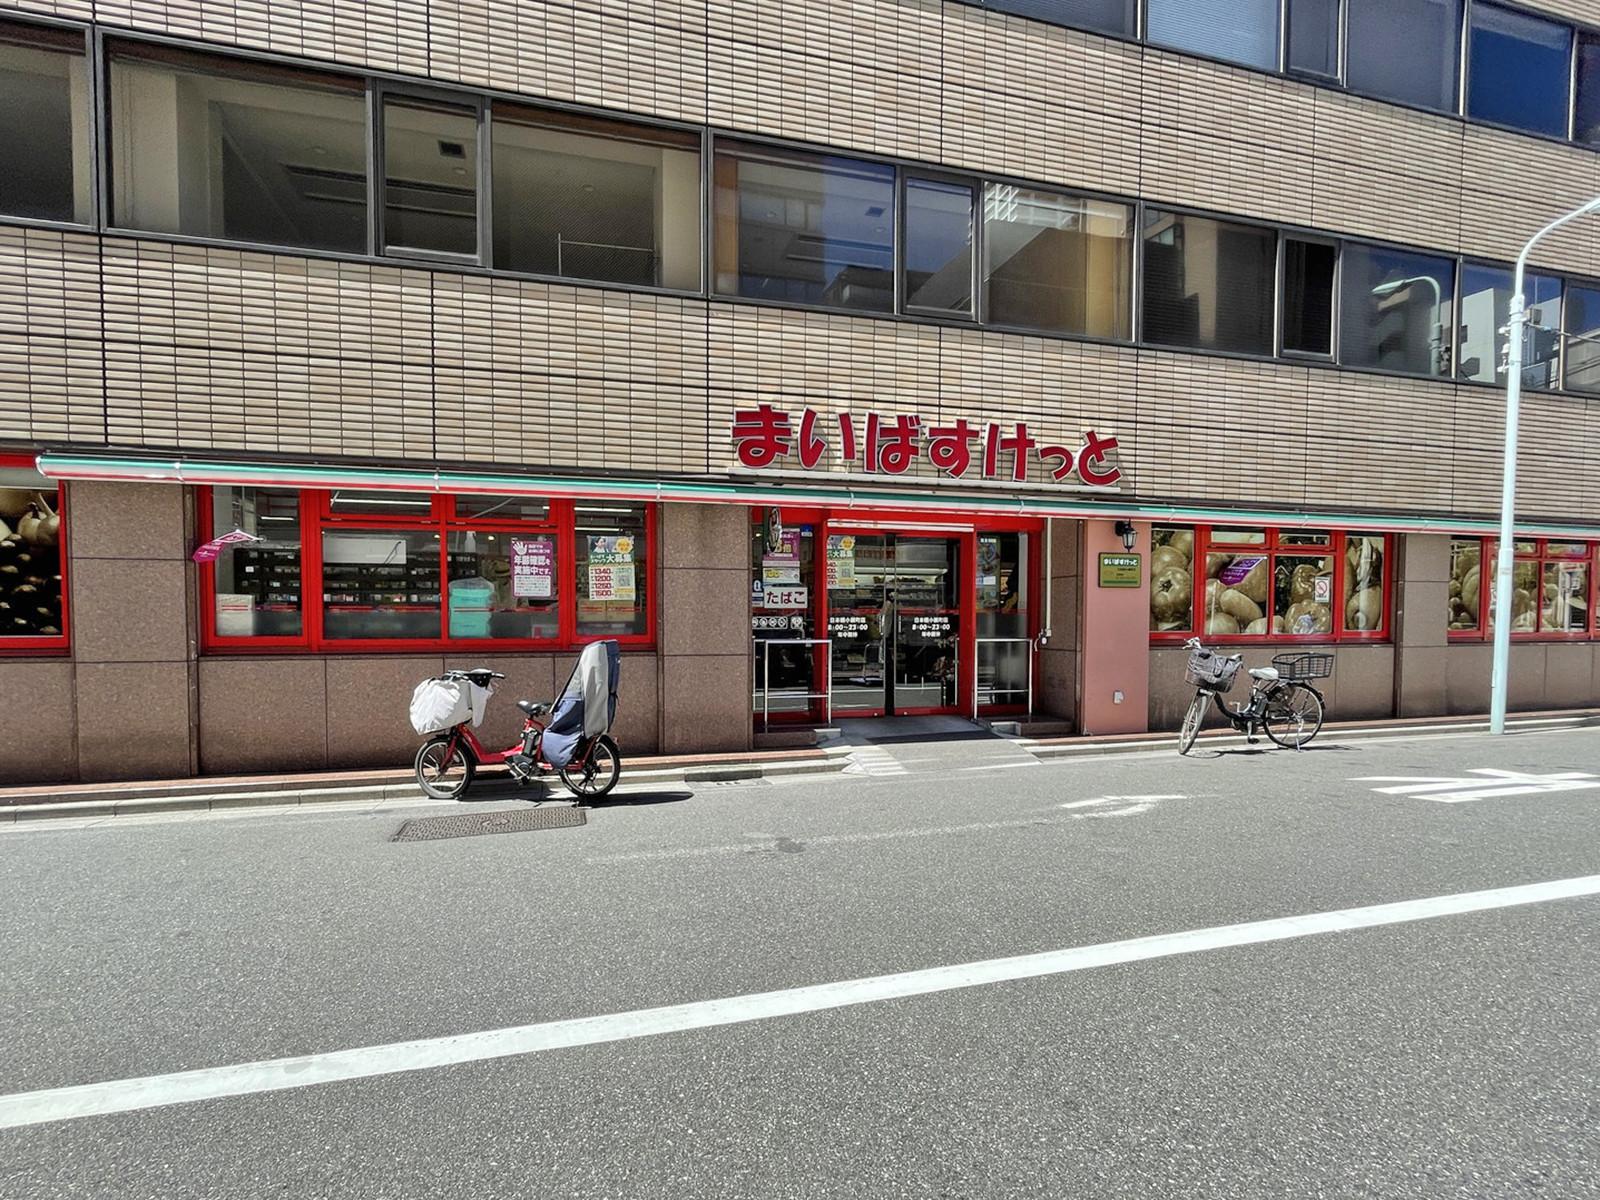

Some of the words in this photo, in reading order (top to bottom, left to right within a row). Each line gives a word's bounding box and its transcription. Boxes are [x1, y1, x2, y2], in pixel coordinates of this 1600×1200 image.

[731, 403, 1122, 486] まいばすけっと
[514, 555, 551, 565] 年齢確認を
[606, 554, 632, 563] 大募集
[766, 591, 806, 604] たばこ
